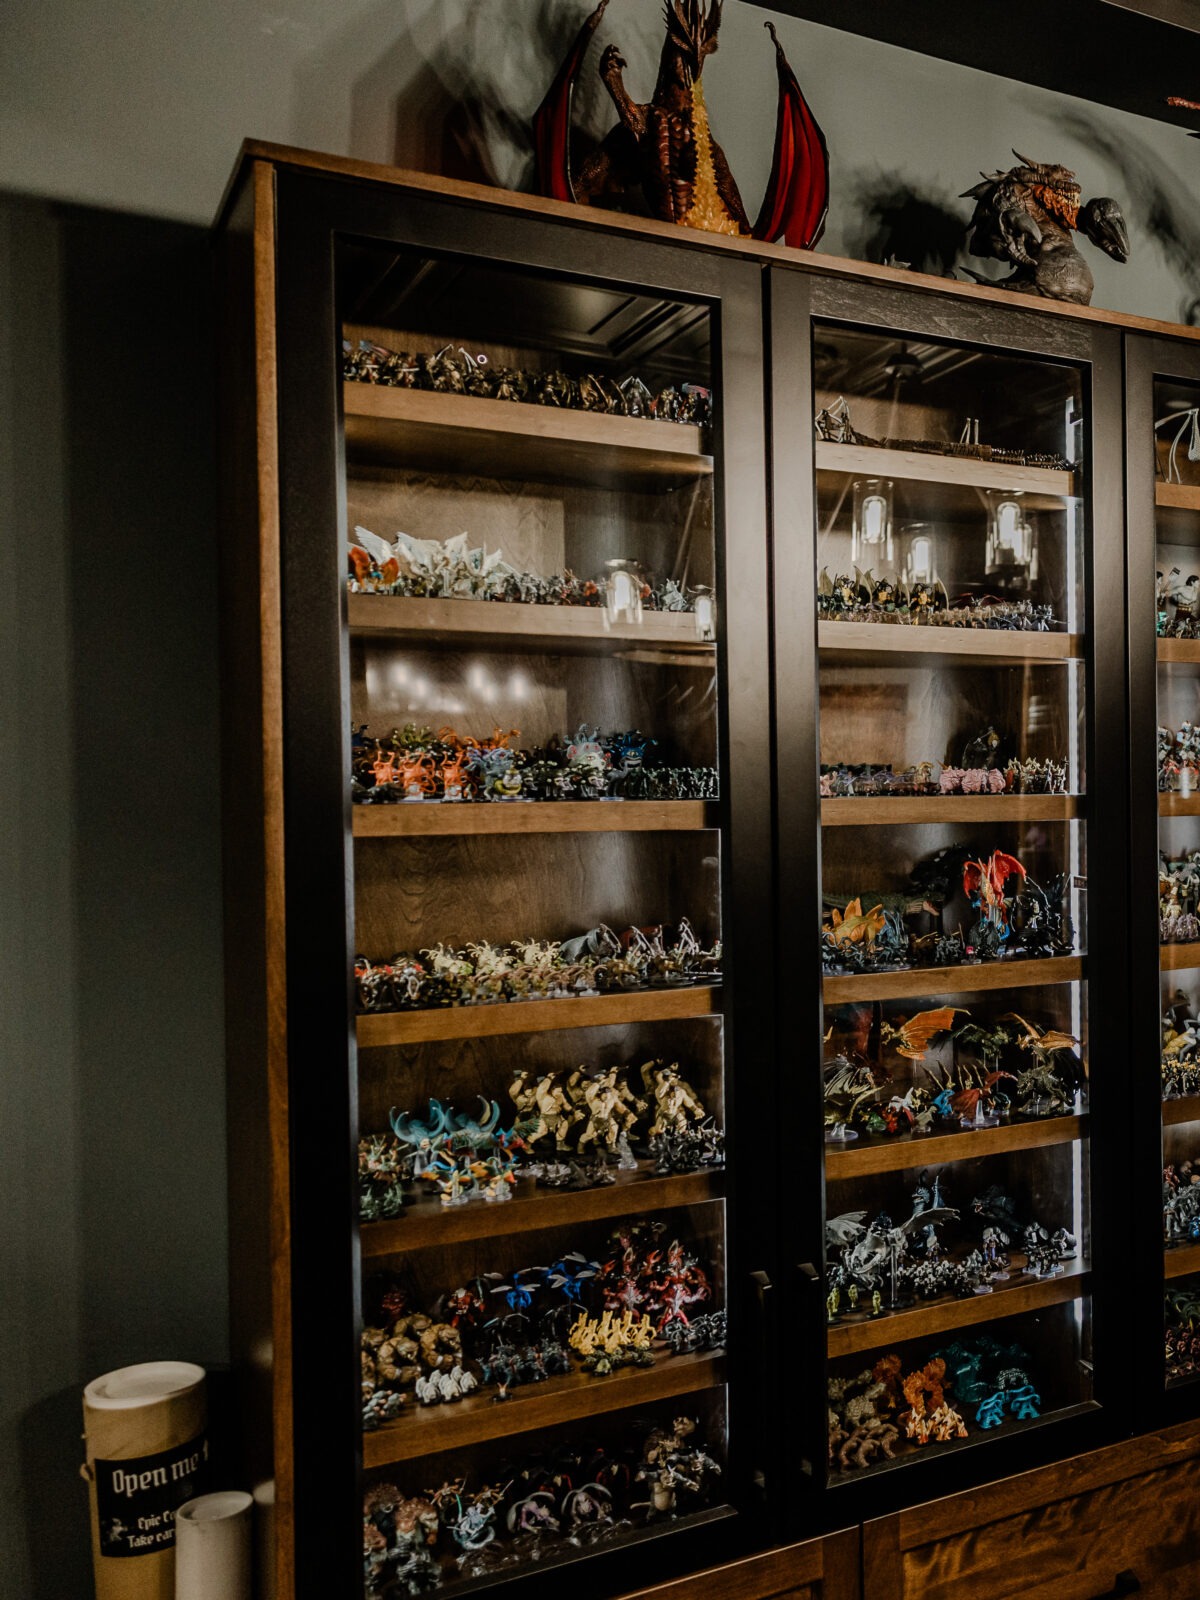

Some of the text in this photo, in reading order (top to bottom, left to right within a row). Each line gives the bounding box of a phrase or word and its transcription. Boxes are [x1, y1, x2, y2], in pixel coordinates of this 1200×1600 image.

[112, 1452, 199, 1498] Open me
[137, 1514, 161, 1530] Epic
[126, 1533, 154, 1549] Take
